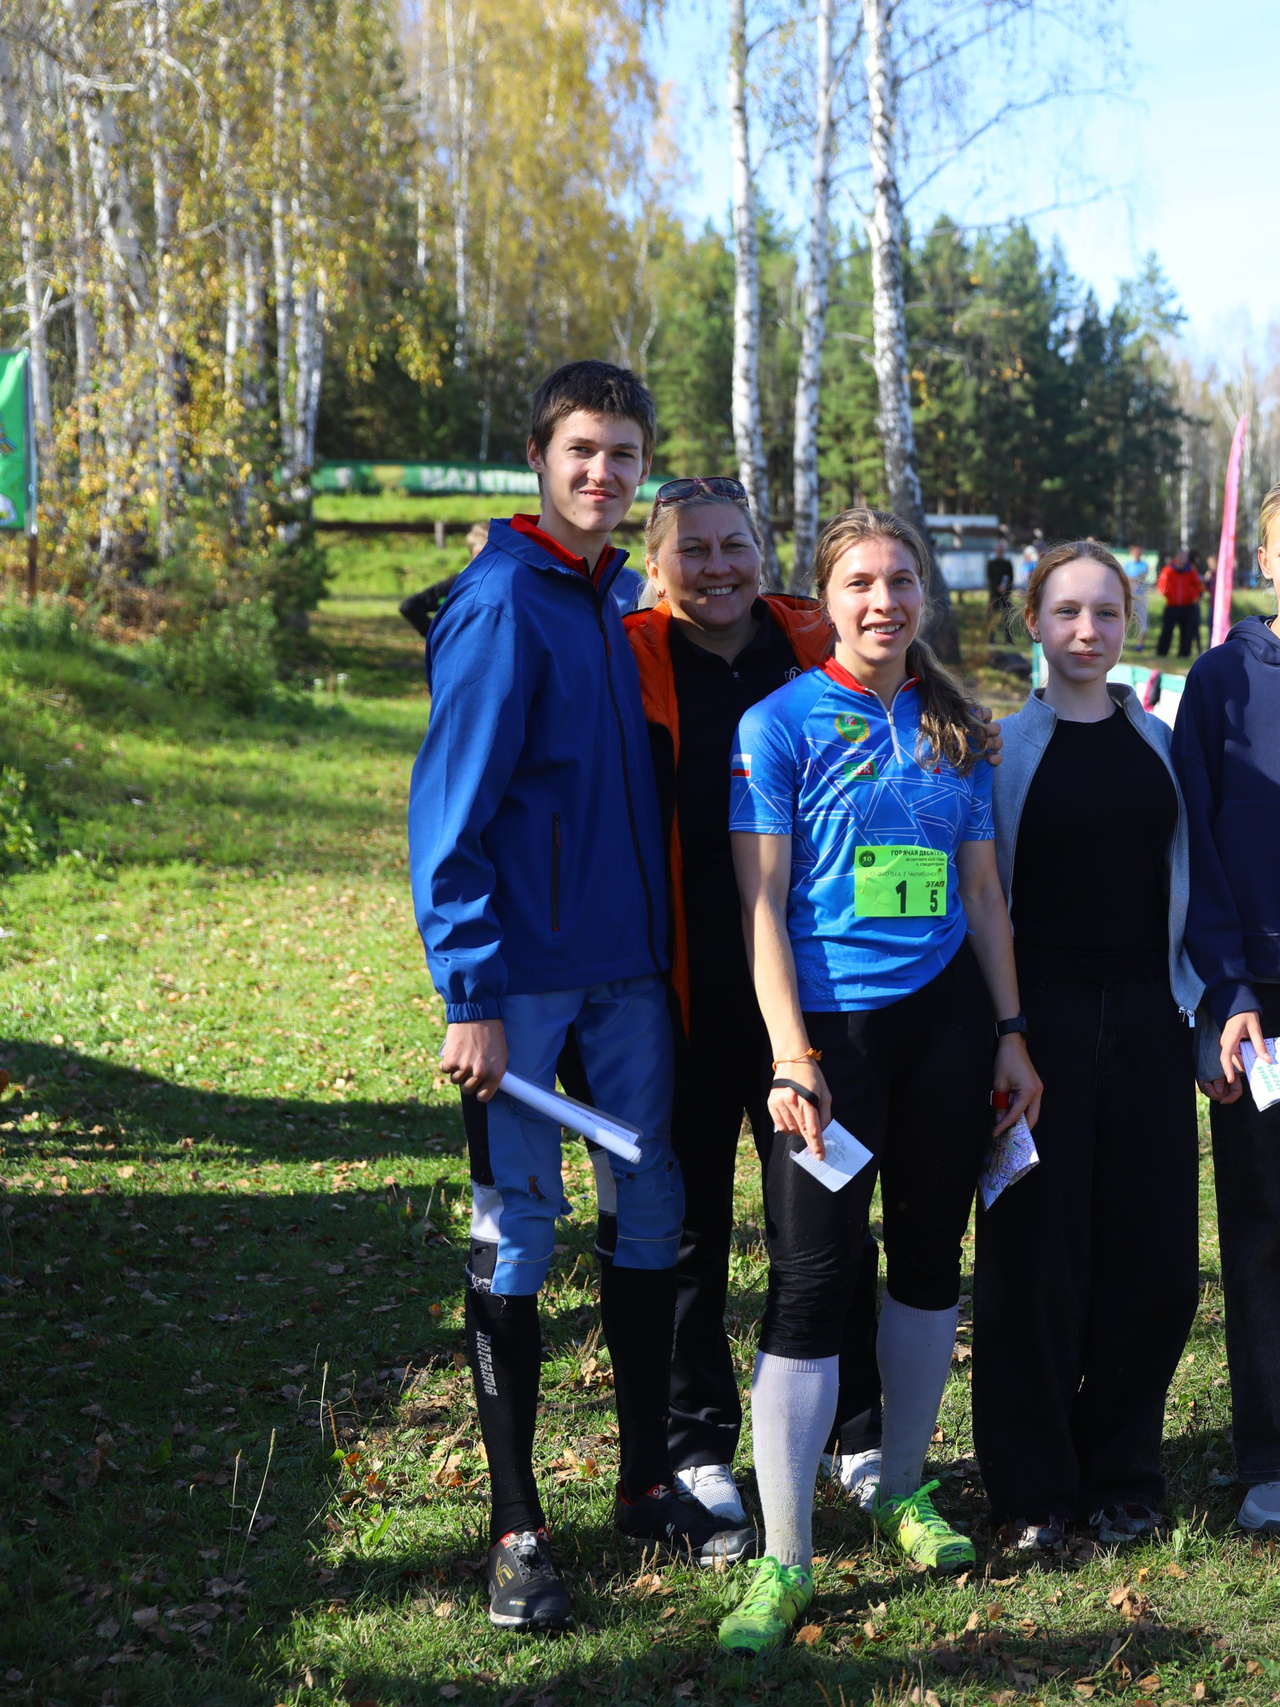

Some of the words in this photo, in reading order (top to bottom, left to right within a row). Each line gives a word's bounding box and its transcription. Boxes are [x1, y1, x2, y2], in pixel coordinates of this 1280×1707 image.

[926, 880, 945, 888] ЭТАП
[895, 880, 907, 914] 1
[929, 890, 938, 913] 5
